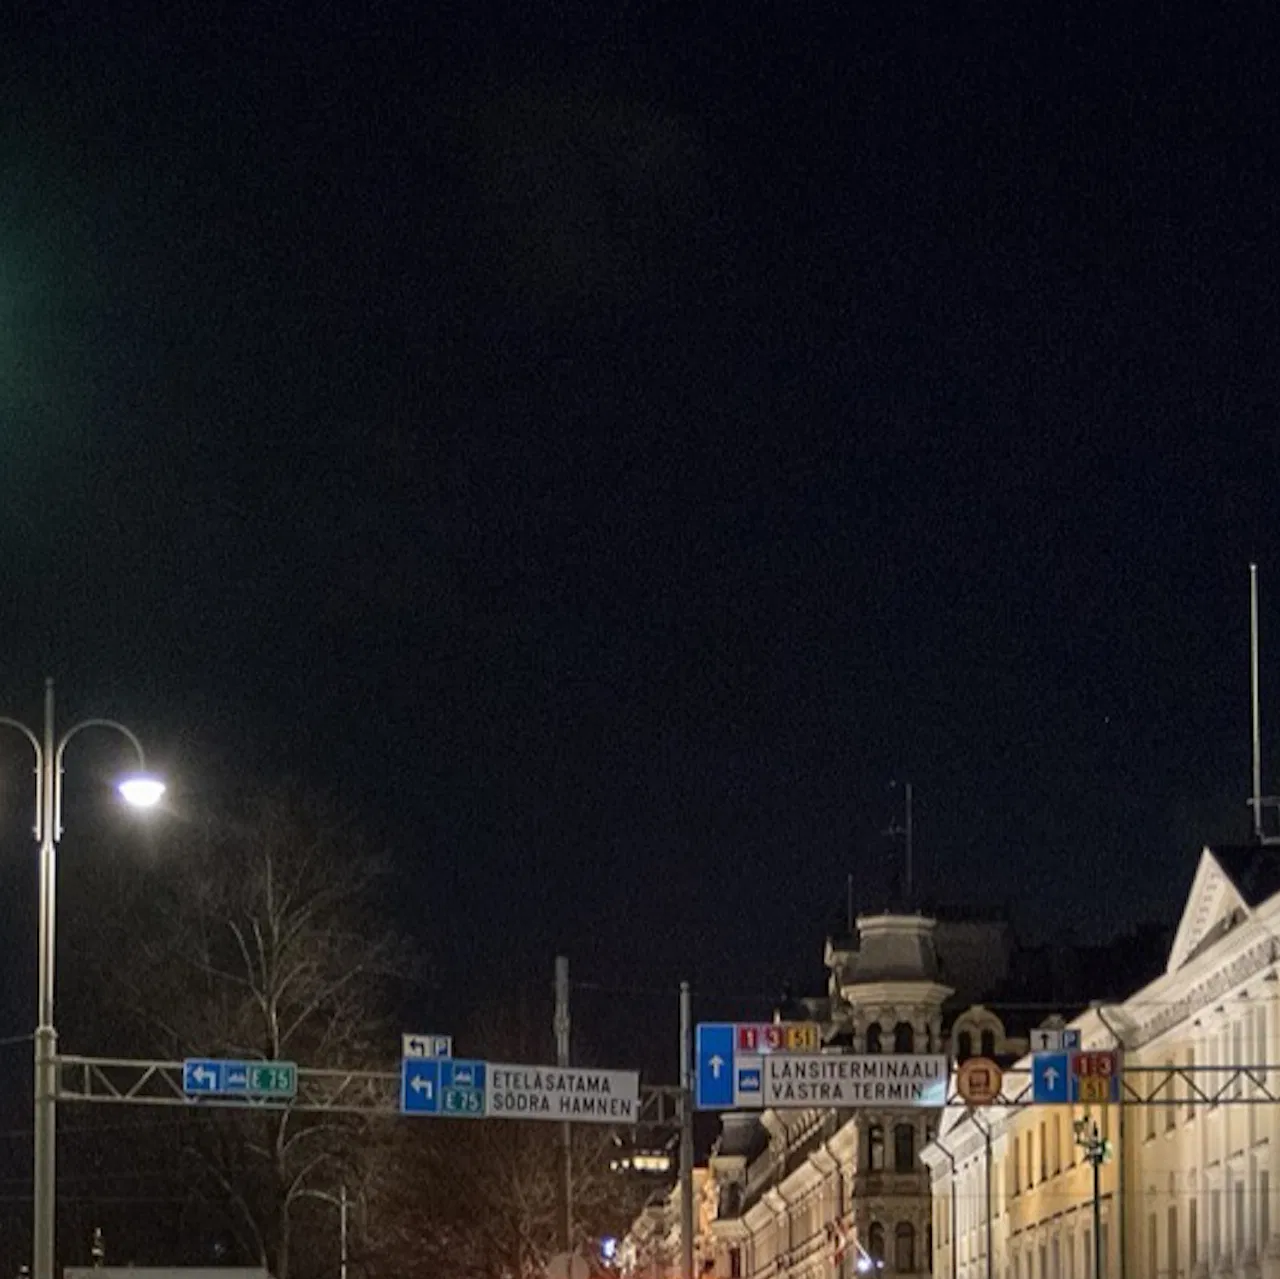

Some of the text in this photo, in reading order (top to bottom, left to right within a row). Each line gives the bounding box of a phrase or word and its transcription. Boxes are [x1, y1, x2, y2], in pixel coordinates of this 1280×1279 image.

[771, 1059, 938, 1079] LÄNSITERMINAALI
[493, 1068, 611, 1093] ETELÄSATAMA
[772, 1080, 842, 1099] VÄSTRA
[493, 1090, 632, 1116] SÖDRA HAMNEN
